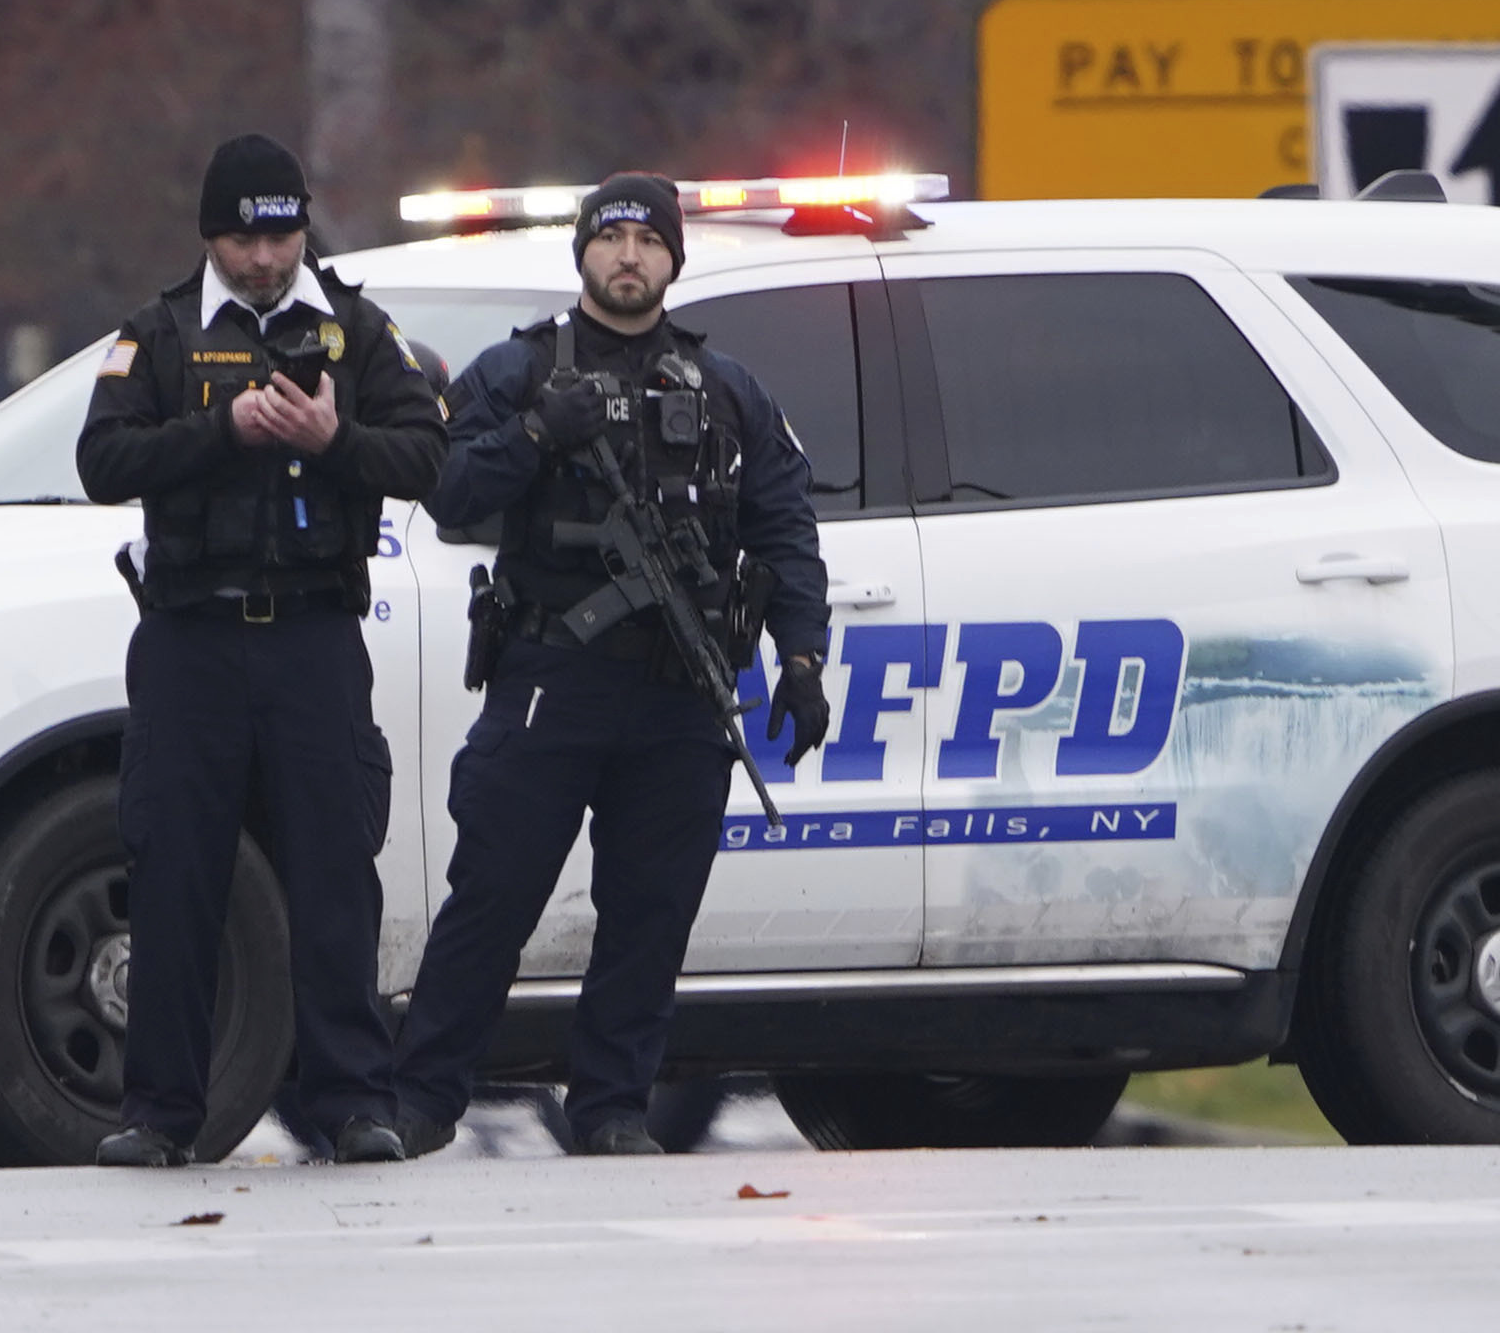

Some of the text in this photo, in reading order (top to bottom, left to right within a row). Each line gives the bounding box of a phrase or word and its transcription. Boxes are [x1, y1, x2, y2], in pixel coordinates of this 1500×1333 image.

[1056, 37, 1304, 91] PAY TO
[606, 397, 630, 421] ICE
[726, 808, 1160, 848] gara Falls, NY
